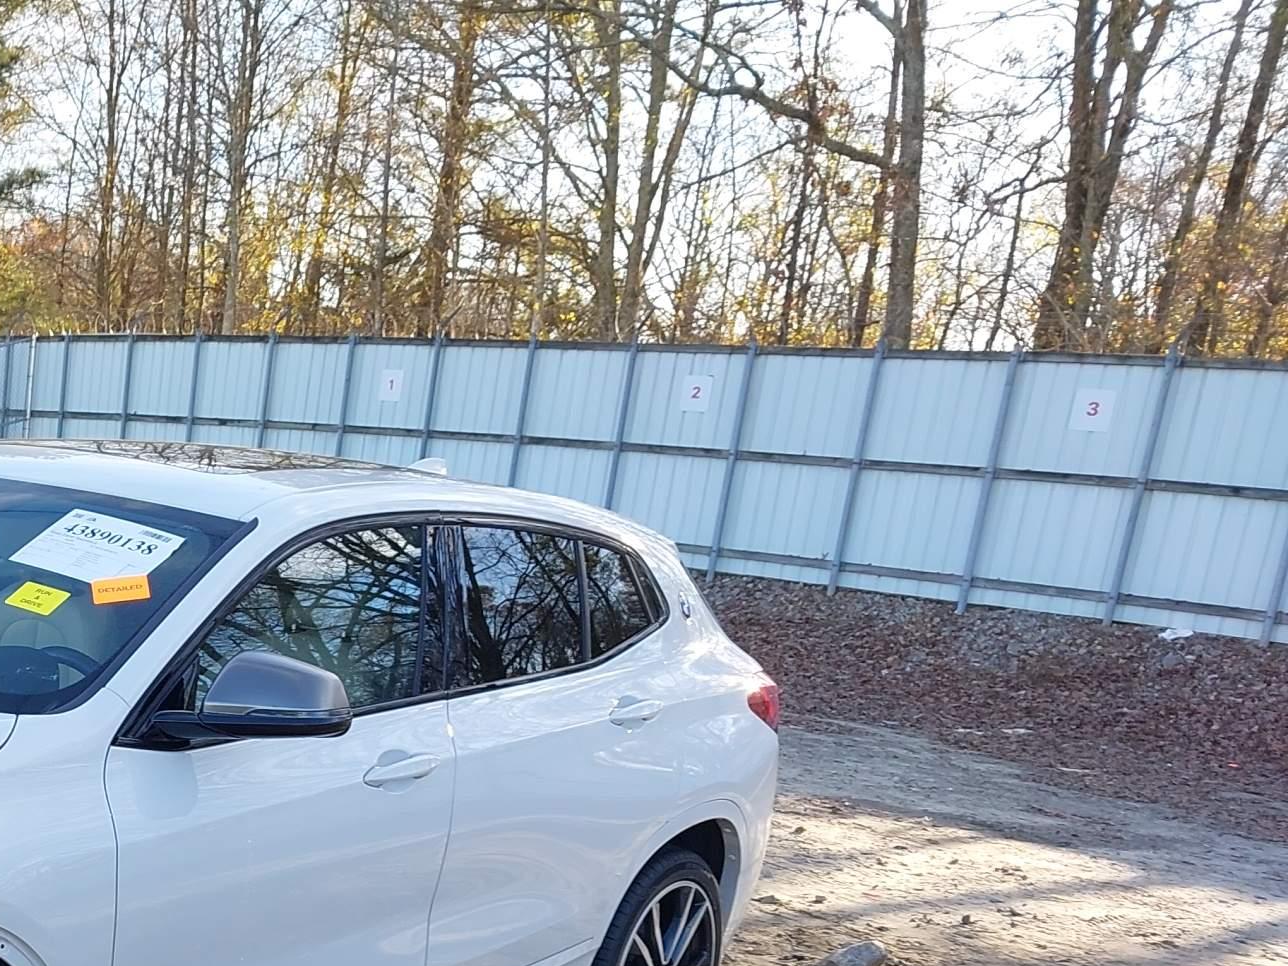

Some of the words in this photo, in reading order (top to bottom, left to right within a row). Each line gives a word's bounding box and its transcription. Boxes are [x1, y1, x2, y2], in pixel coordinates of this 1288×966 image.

[691, 386, 702, 399] 2
[1086, 401, 1100, 416] 3
[63, 523, 158, 556] 43890138
[36, 588, 54, 596] RUN
[97, 584, 144, 594] DETAILED
[19, 598, 44, 609] DRIVE
